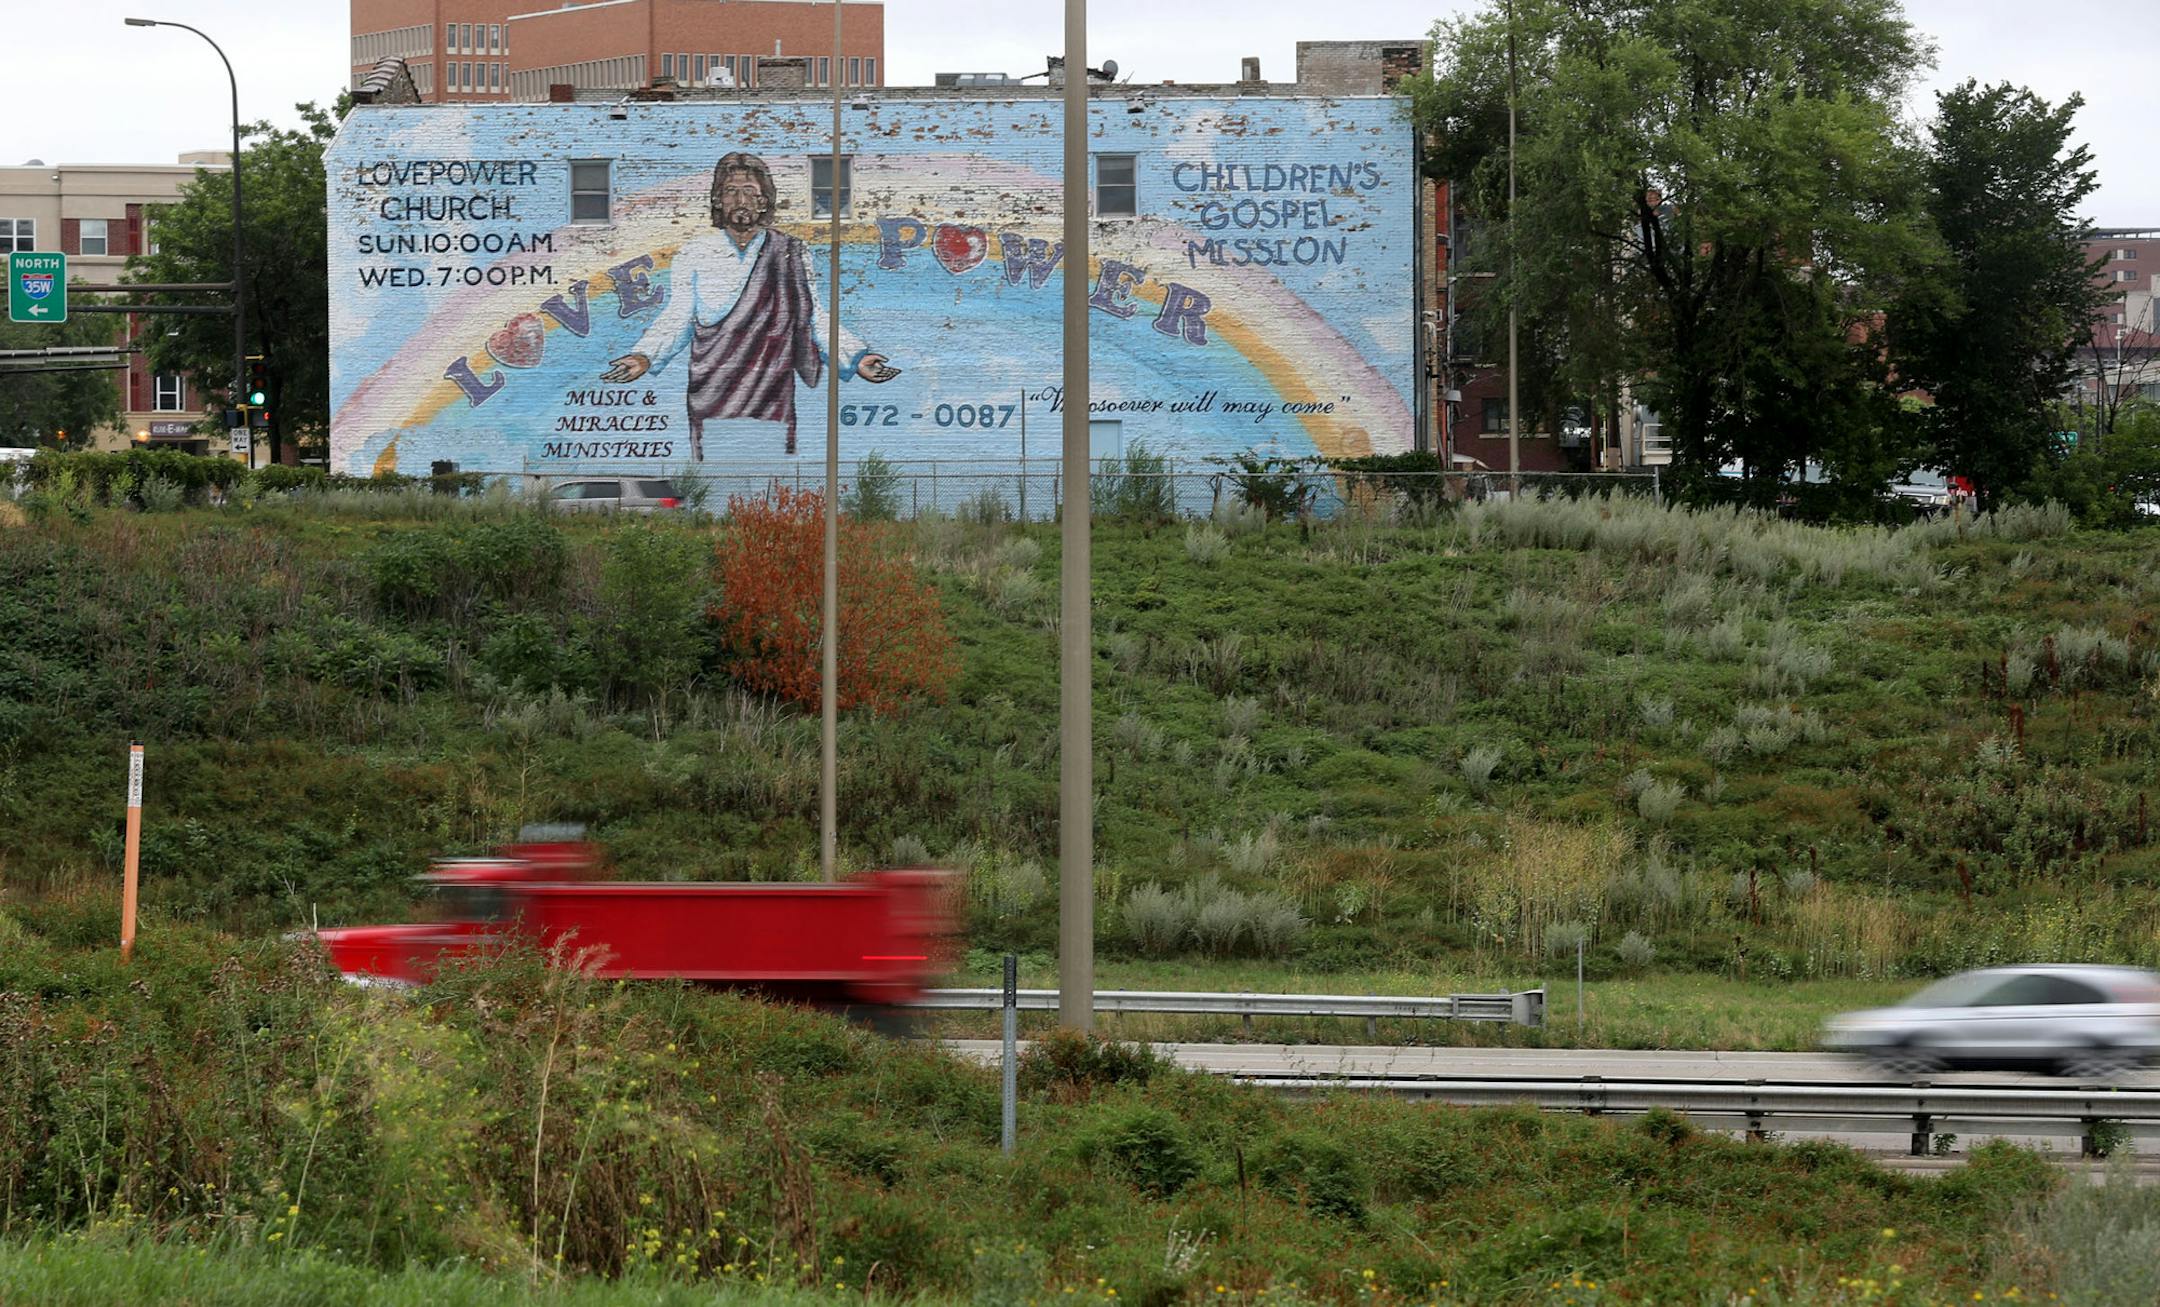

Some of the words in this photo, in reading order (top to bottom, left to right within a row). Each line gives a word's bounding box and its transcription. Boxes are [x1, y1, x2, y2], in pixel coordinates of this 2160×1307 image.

[357, 160, 538, 187] LOVEPOWER
[1172, 161, 1381, 193] CHILDREN'S
[380, 195, 512, 222] CHURCH
[1200, 199, 1338, 231] GOSPEL
[15, 258, 60, 269] NORTH
[1186, 236, 1348, 270] MISSION
[25, 280, 51, 294] 35W
[358, 267, 432, 288] WED.
[564, 389, 639, 407] MUSIC
[642, 390, 658, 406] &
[1171, 391, 1219, 413] will
[1222, 402, 1274, 424] may
[555, 414, 670, 432] MIRACLES
[839, 404, 899, 427] 672
[934, 403, 1017, 429] 0087
[541, 440, 674, 458] MINISTRIES
